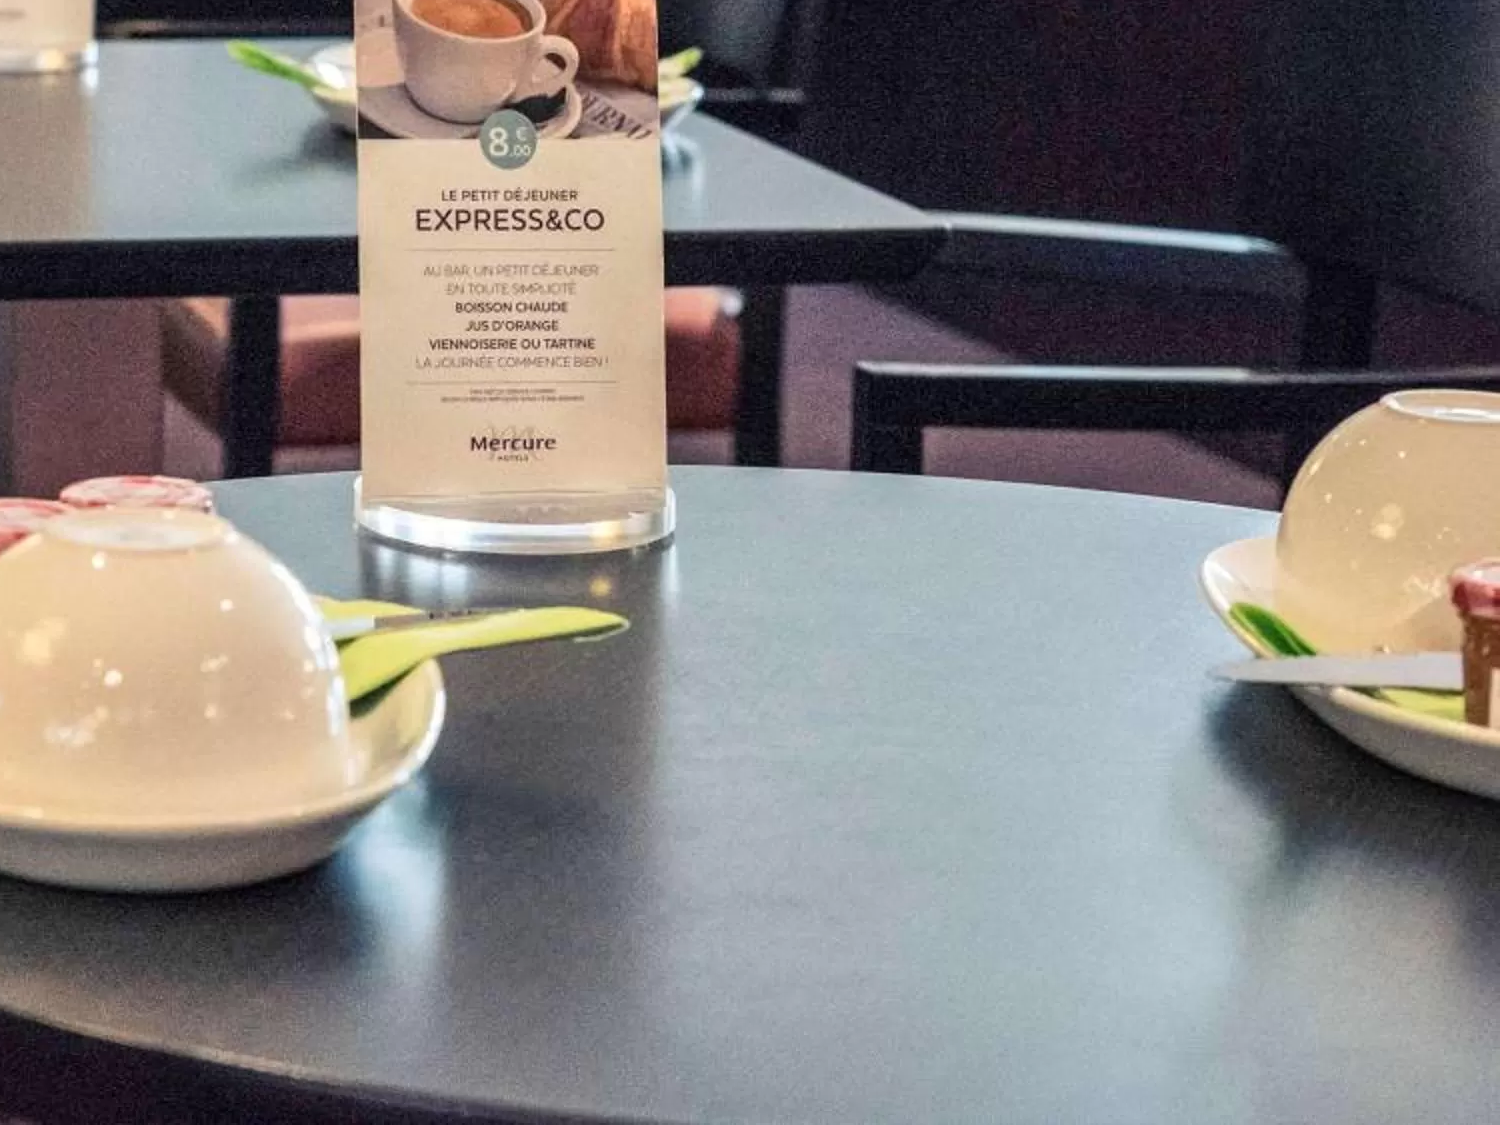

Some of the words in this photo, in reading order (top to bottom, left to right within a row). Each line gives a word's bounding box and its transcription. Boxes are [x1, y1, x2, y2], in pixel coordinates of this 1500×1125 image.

[442, 191, 457, 201] LE
[461, 191, 500, 201] PETIT
[503, 187, 577, 201] DÉJEUNER
[415, 209, 604, 231] EXPRESS&CO
[423, 266, 440, 277] AU
[473, 265, 494, 276] UN
[496, 265, 529, 276] PETIT
[531, 262, 598, 276] DÉJEUNER
[446, 284, 465, 295] EN
[468, 284, 509, 295] TOUTE
[455, 302, 512, 313] BOISSON
[516, 302, 568, 312] CHAUDE
[465, 321, 489, 332] JUS
[492, 320, 559, 331] D'ORANGE
[429, 339, 516, 350] VIENNOISERIE
[521, 339, 541, 349] OU
[544, 338, 596, 349] TARTINE
[416, 358, 431, 369] LA
[435, 354, 494, 369] JOURNÉE
[498, 357, 572, 368] COMMENCE
[574, 357, 603, 368] BIEN
[470, 437, 556, 451] Mercure
